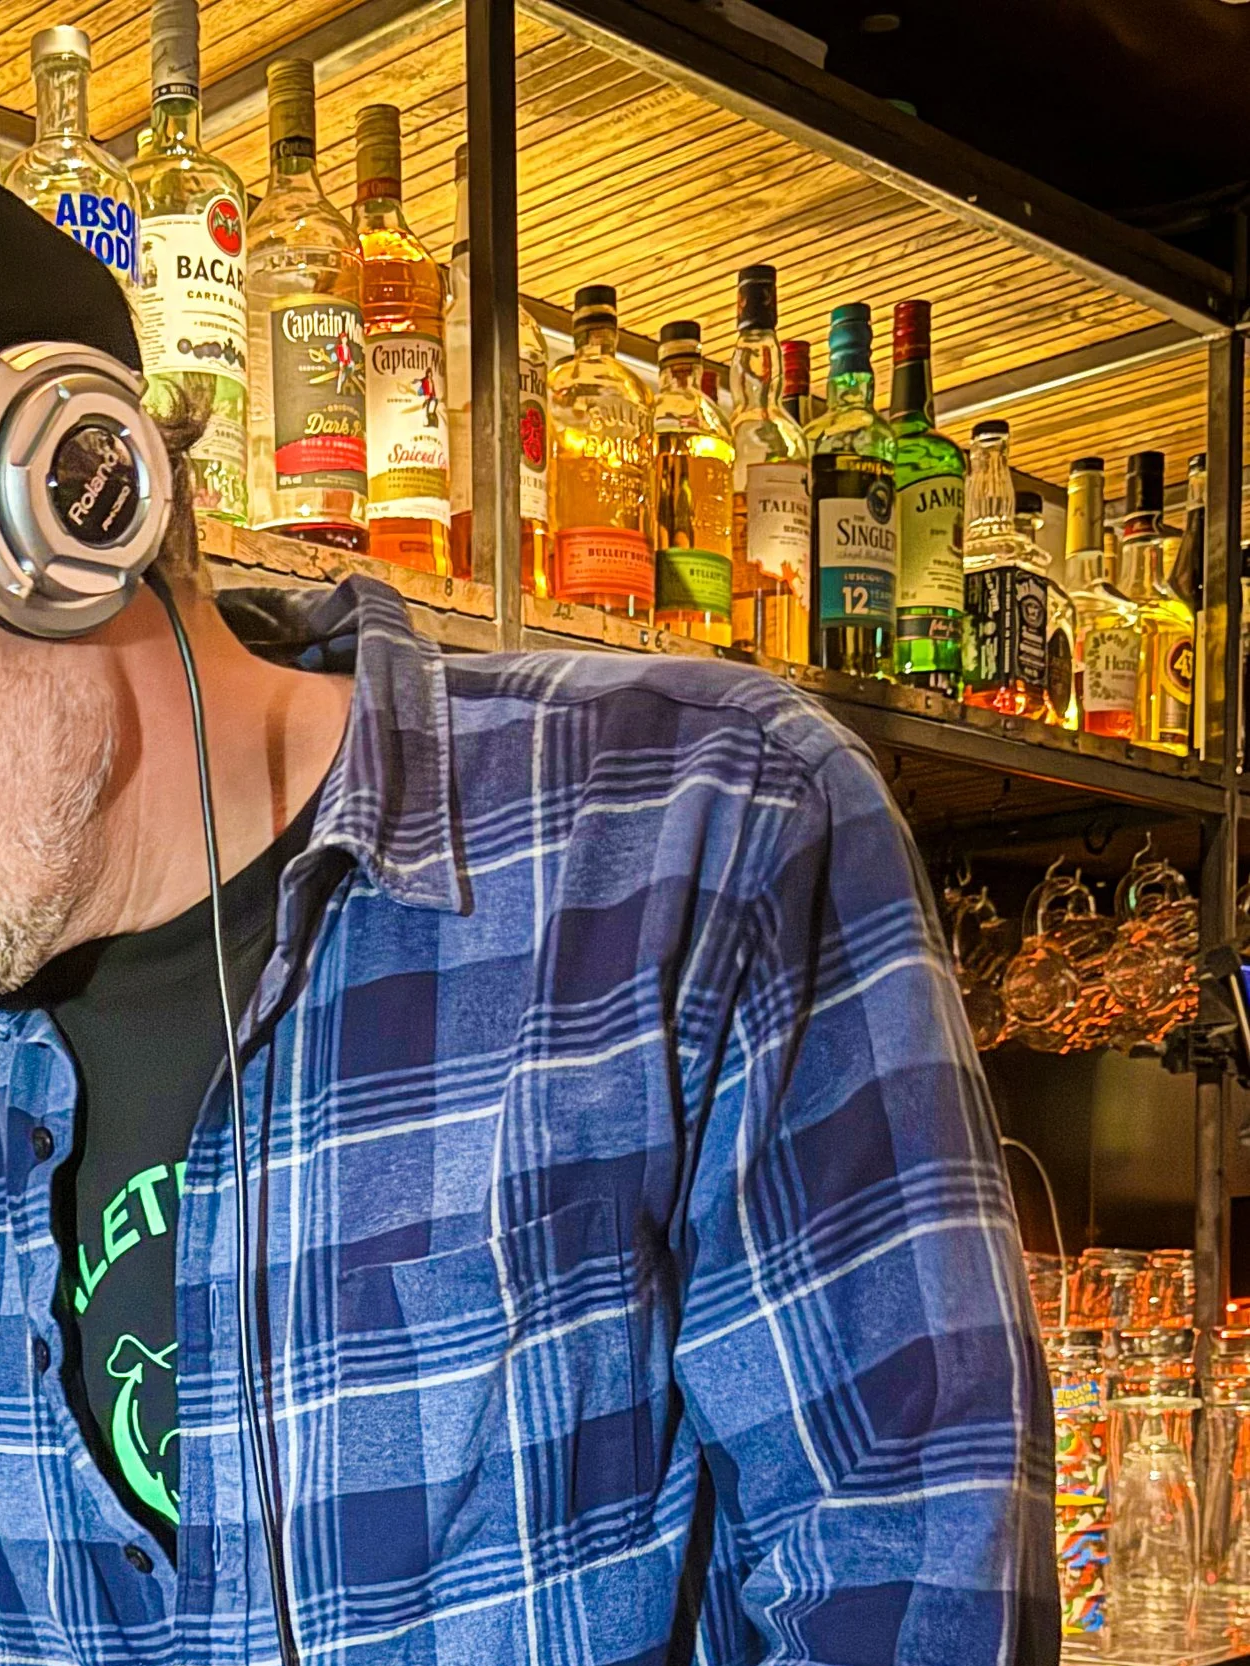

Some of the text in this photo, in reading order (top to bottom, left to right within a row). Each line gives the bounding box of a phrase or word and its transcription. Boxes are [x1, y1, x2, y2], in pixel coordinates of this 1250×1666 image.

[72, 230, 139, 278] VOD
[187, 290, 225, 303] CARTA
[282, 307, 343, 343] Captain
[372, 343, 428, 376] Captain
[387, 443, 437, 465] Spiced
[68, 446, 120, 526] Roland
[842, 585, 869, 615] 12
[74, 1161, 188, 1315] LET
